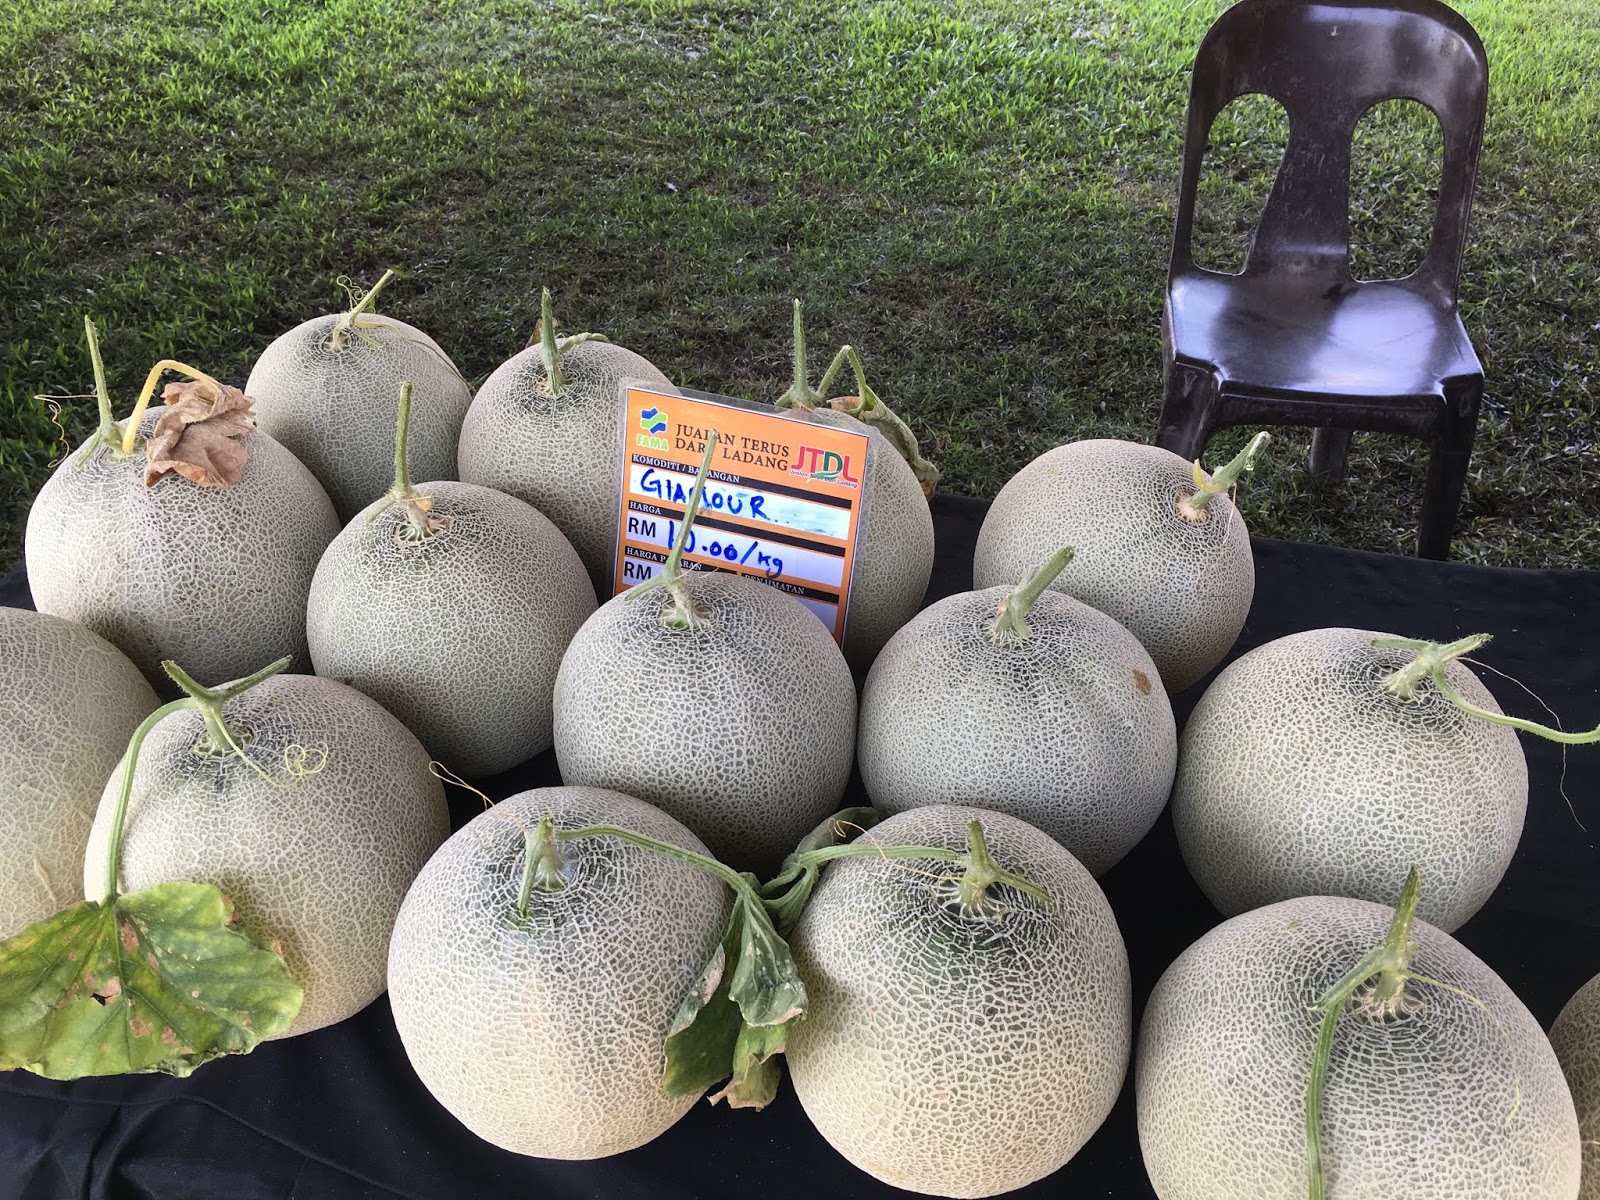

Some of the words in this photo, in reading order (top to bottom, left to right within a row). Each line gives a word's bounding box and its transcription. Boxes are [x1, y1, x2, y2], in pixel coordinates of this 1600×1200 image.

[636, 434, 669, 452] FAMA
[741, 437, 789, 457] TERUS
[675, 438, 708, 454] DAR
[722, 448, 788, 471] LADANG
[791, 446, 858, 482] JTDL
[633, 454, 680, 470] KOMODITI
[688, 466, 740, 483] BAANGAN
[629, 501, 661, 515] HARGA
[628, 517, 656, 538] RM
[626, 547, 658, 561] HARGA
[660, 555, 702, 570] PRAN
[624, 561, 652, 580] RM
